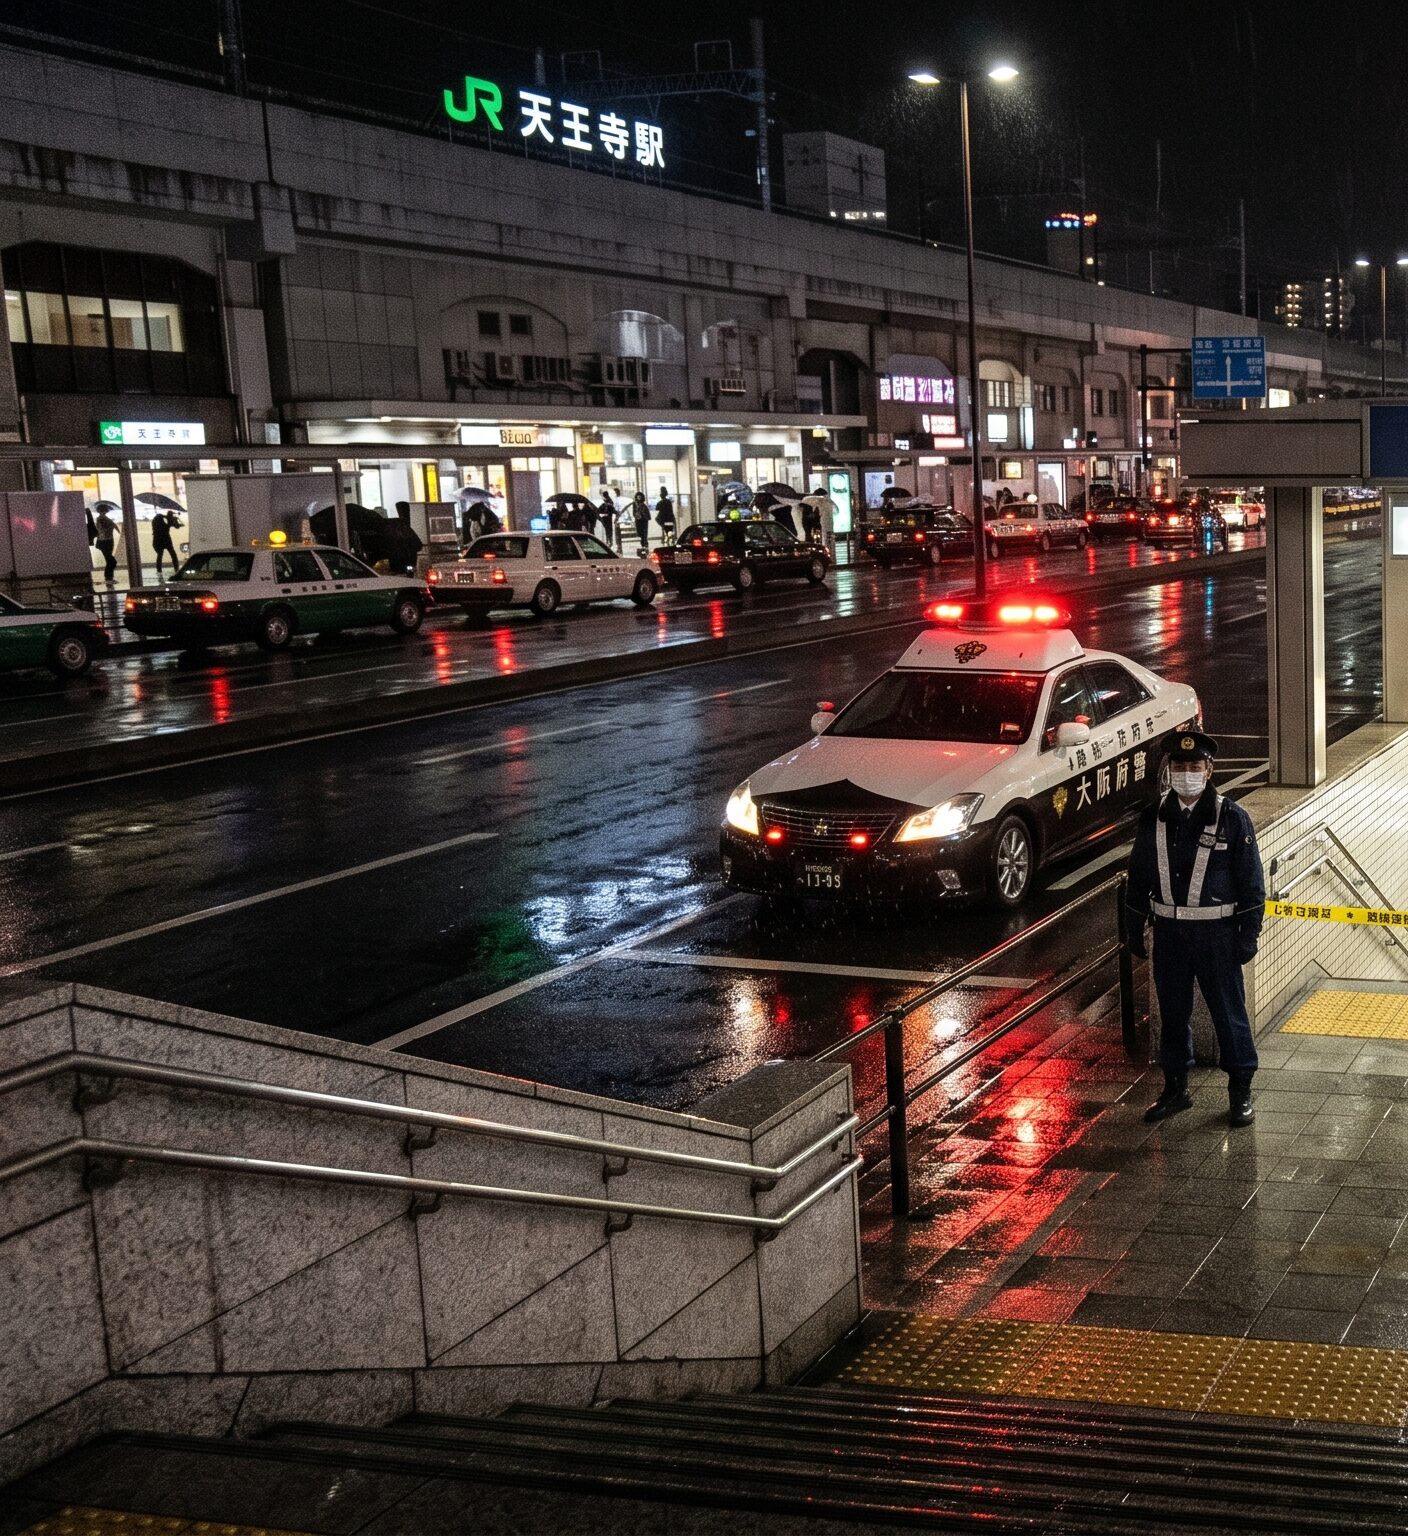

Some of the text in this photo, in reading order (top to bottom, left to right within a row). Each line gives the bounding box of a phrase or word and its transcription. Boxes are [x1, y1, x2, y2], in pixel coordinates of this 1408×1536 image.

[443, 75, 665, 169] JR 天王寺駅
